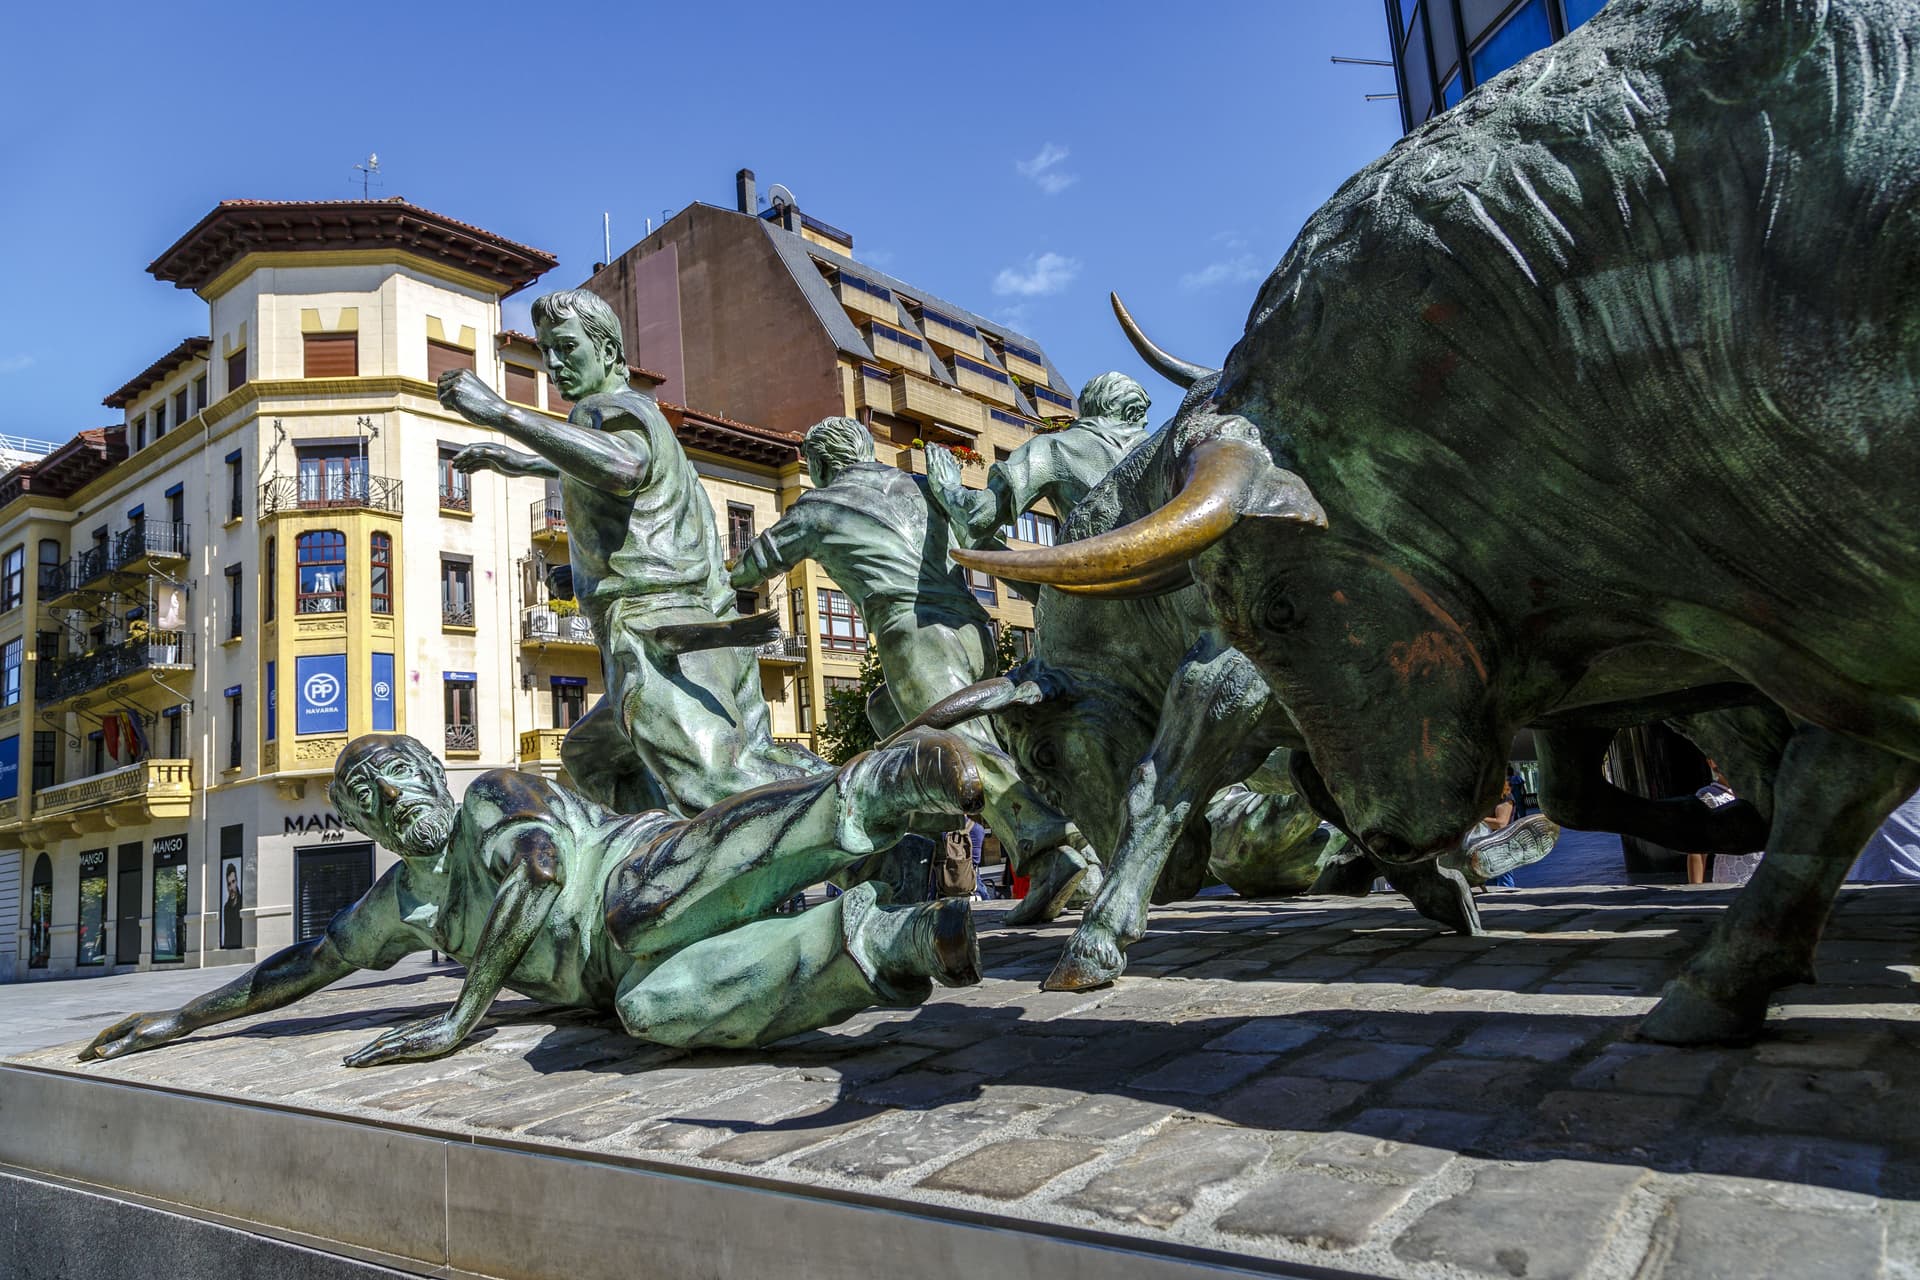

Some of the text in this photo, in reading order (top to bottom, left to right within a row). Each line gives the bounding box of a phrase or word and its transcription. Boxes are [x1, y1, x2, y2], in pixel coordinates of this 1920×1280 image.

[311, 684, 333, 699] PP
[305, 707, 339, 715] NAVARRA
[284, 813, 354, 833] MAN
[153, 838, 183, 854] MANGO
[80, 852, 104, 865] MANGO
